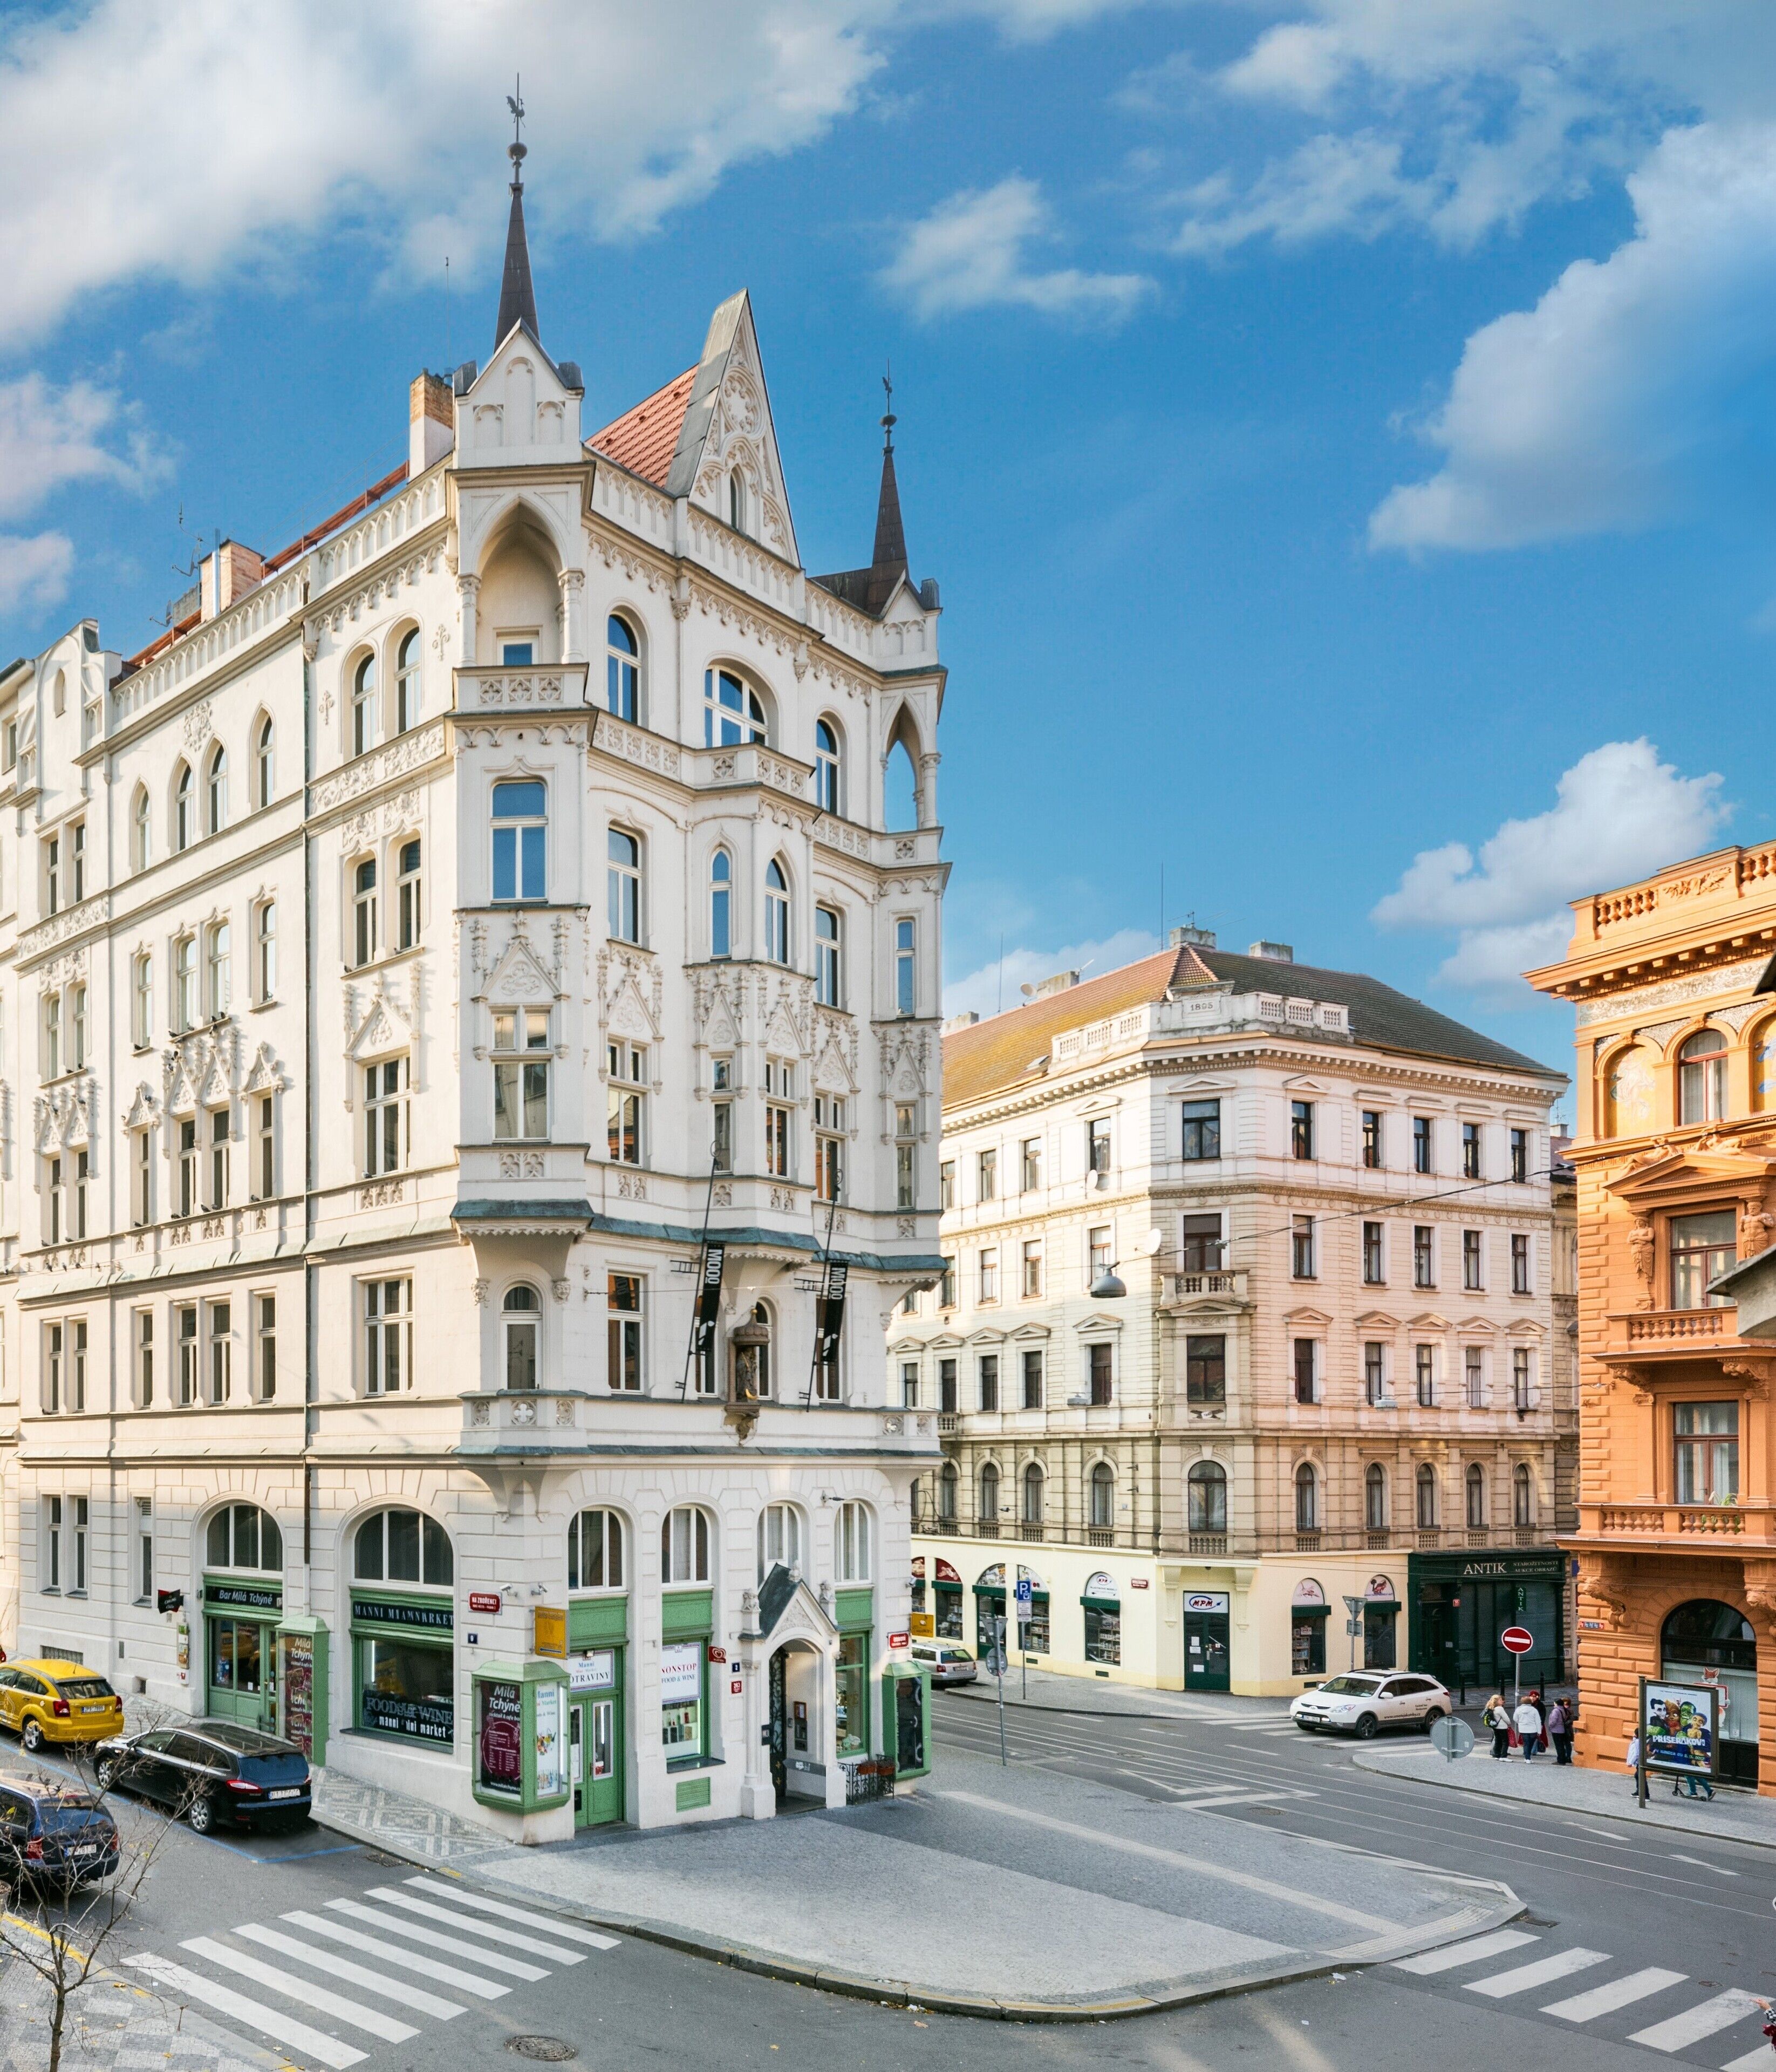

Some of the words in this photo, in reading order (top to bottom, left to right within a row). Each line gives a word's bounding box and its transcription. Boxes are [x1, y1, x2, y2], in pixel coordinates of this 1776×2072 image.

[1191, 1002, 1213, 1011] 1895
[1464, 1563, 1507, 1575] ANTIK
[1020, 1583, 1028, 1595] P
[219, 1590, 231, 1599] Bar
[231, 1591, 247, 1601] Milá
[249, 1592, 272, 1605] Tchýně
[354, 1605, 383, 1618] MANNI
[295, 1637, 311, 1649] Milá
[578, 1660, 595, 1668] Manni
[661, 1662, 697, 1674] NONSTOP
[571, 1672, 610, 1684] TRAVINY
[494, 1685, 515, 1699] Milá
[489, 1698, 520, 1713] Tchýně
[418, 1706, 453, 1725] WINE
[379, 1716, 399, 1729] manni
[420, 1723, 446, 1739] market
